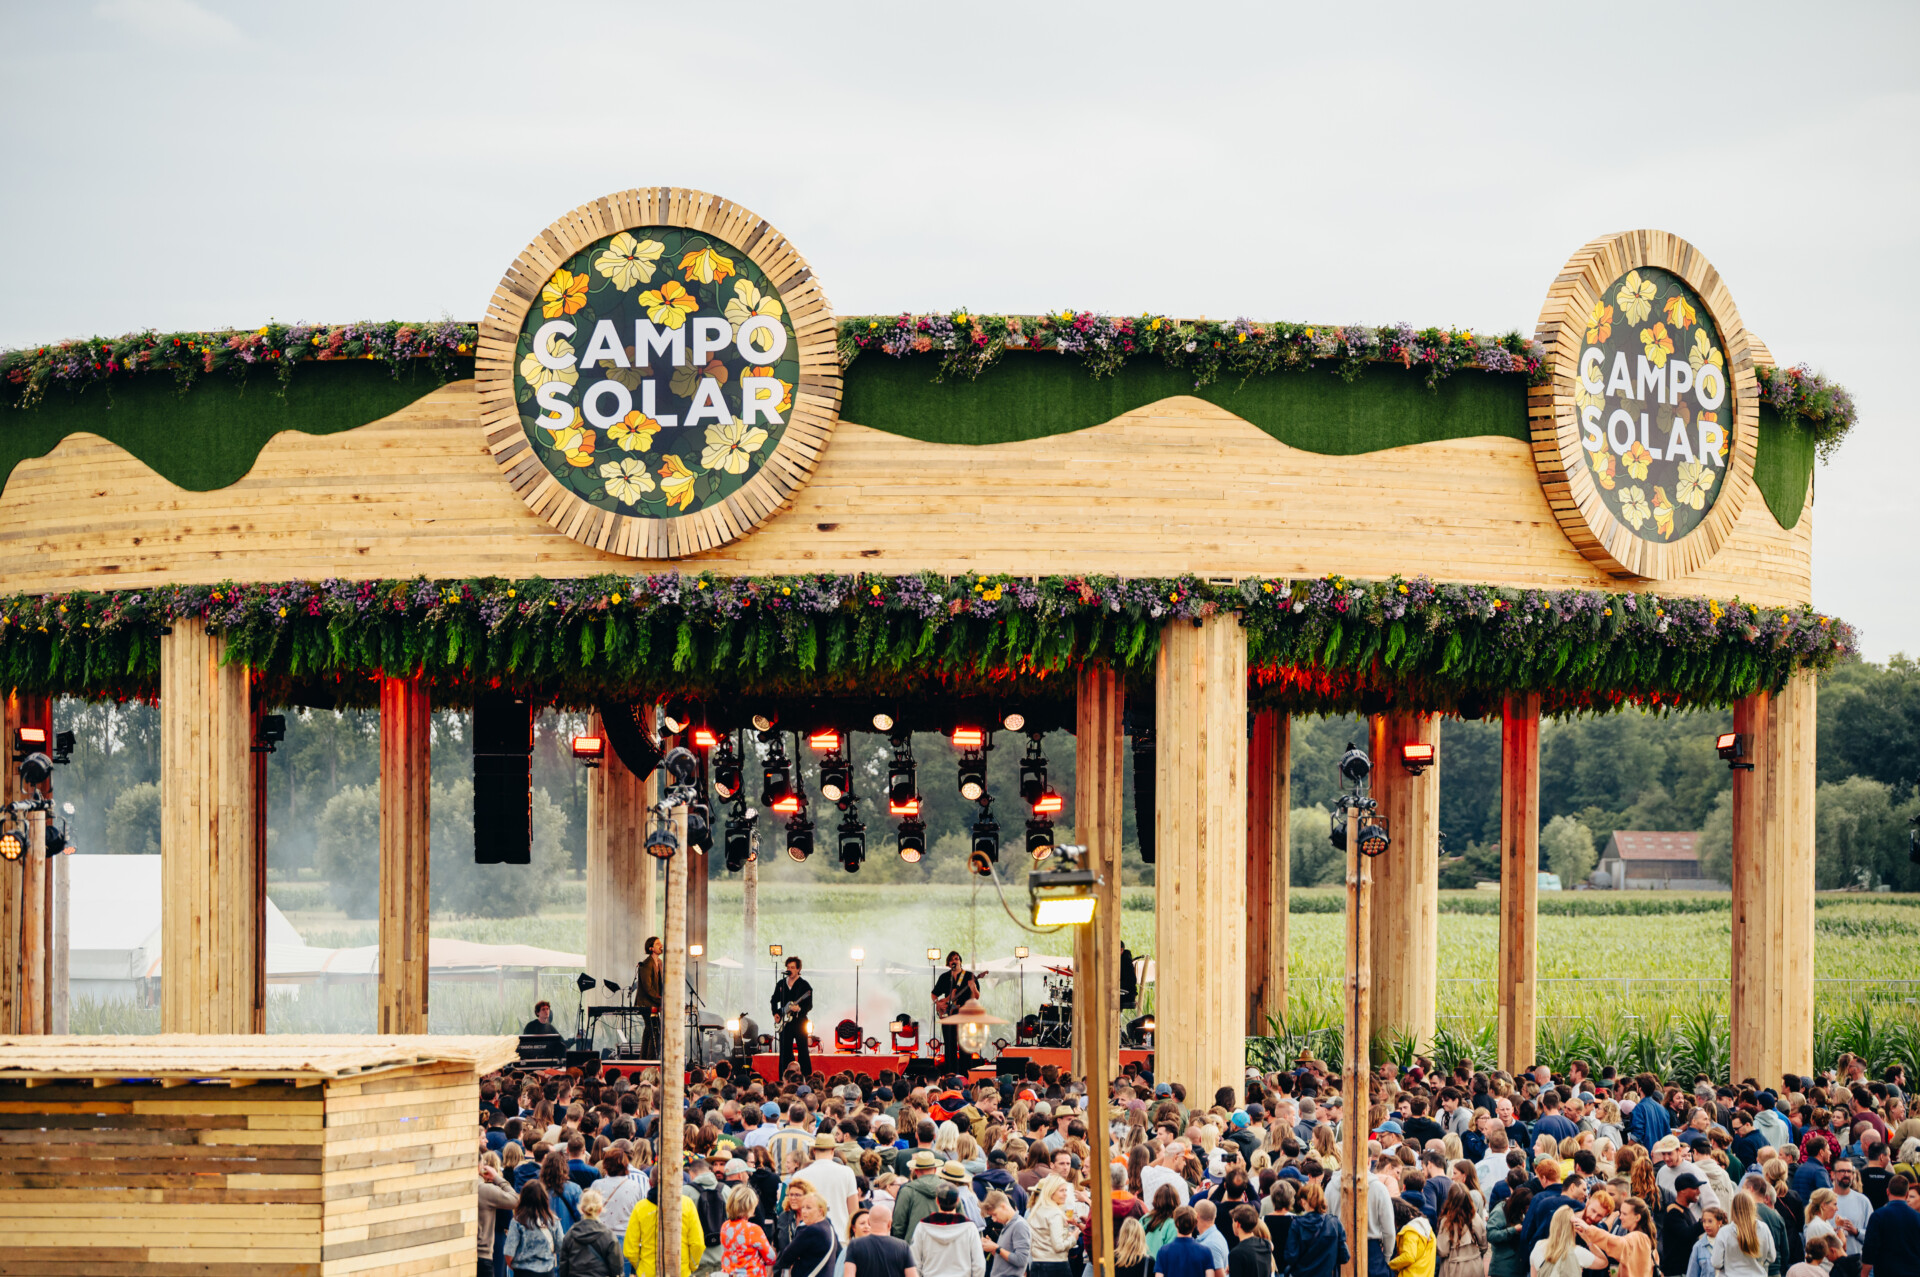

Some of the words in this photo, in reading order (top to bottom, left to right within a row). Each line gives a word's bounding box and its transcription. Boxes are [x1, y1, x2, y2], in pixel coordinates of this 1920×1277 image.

[533, 315, 787, 370] CAMPO
[535, 376, 785, 430] SOLAR
[1580, 347, 1725, 411] CAMPO
[1581, 405, 1725, 467] SOLAR
